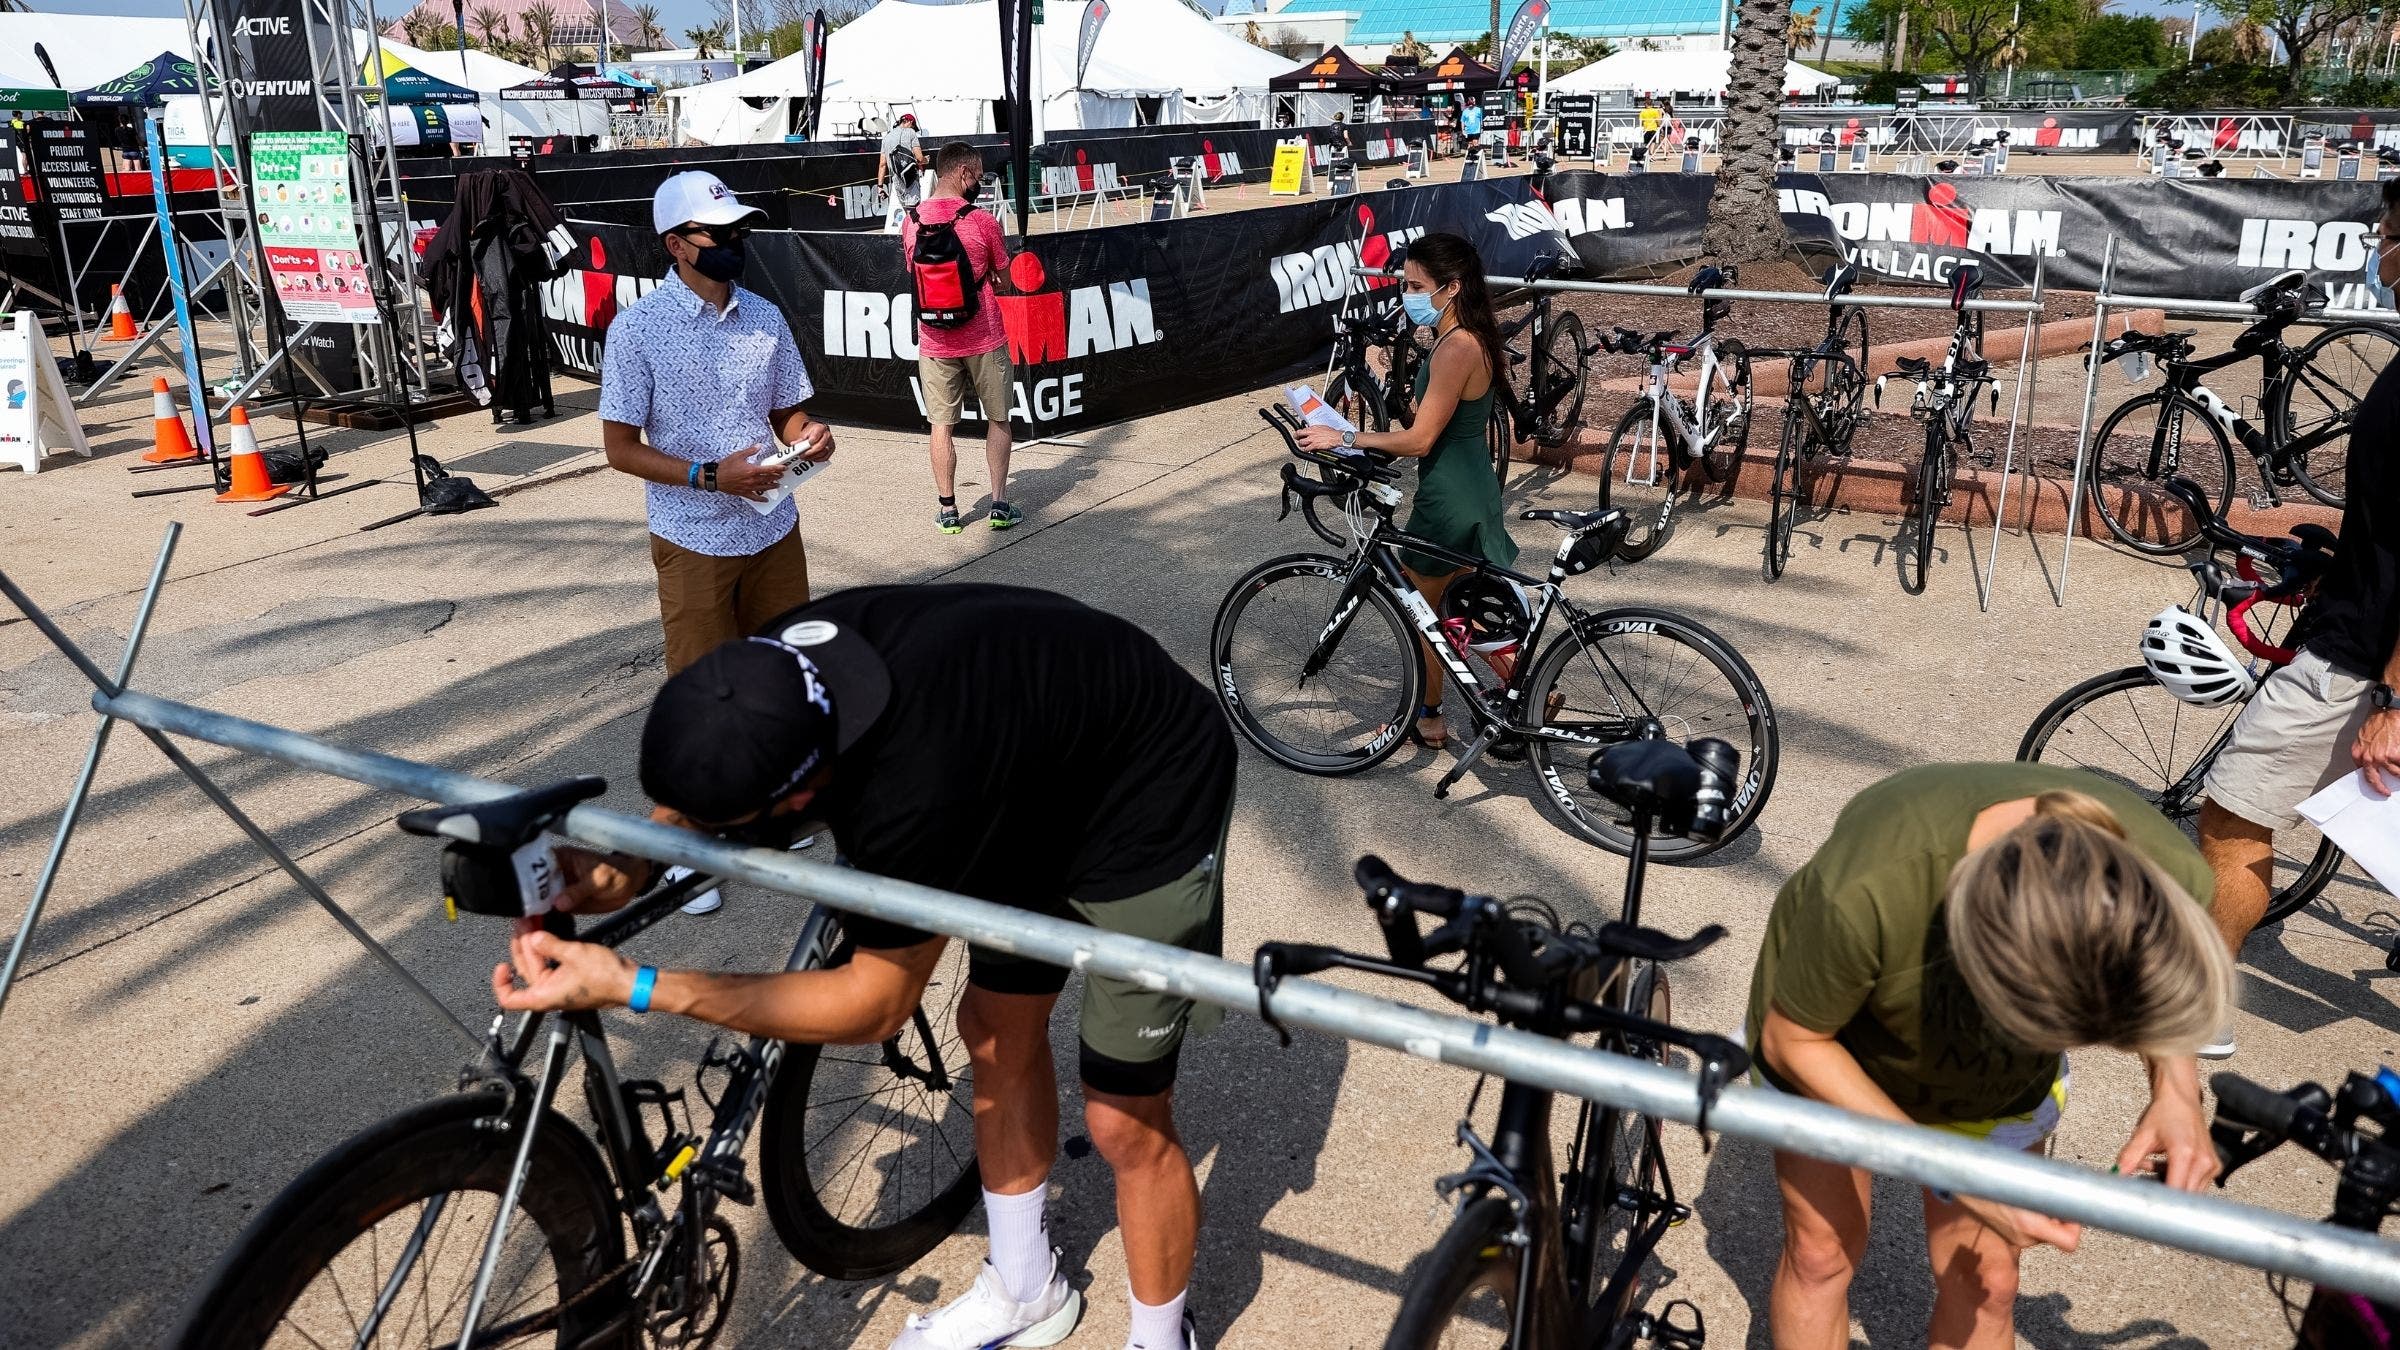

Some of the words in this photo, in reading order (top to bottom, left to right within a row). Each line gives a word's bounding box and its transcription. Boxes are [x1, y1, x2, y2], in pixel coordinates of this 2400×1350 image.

[232, 16, 292, 37] ACTIVE
[50, 145, 84, 156] PRIORITY
[41, 162, 70, 173] ACCESS
[71, 162, 89, 172] LANE
[47, 177, 99, 189] VOLUNTEERS,
[51, 192, 95, 204] EXHIBITORS
[59, 208, 82, 219] STAFF
[83, 208, 102, 218] ONLY
[310, 335, 335, 348] Watch
[2168, 419, 2181, 467] QUINTANA
[1319, 595, 1359, 643] FUJI
[1608, 620, 1659, 635] OVAL
[1220, 662, 1239, 705] OVAL
[1364, 723, 1400, 756] OVAL
[1538, 726, 1601, 744] FUJI
[1543, 765, 1576, 812] OVAL
[1731, 769, 1761, 816] OVAL
